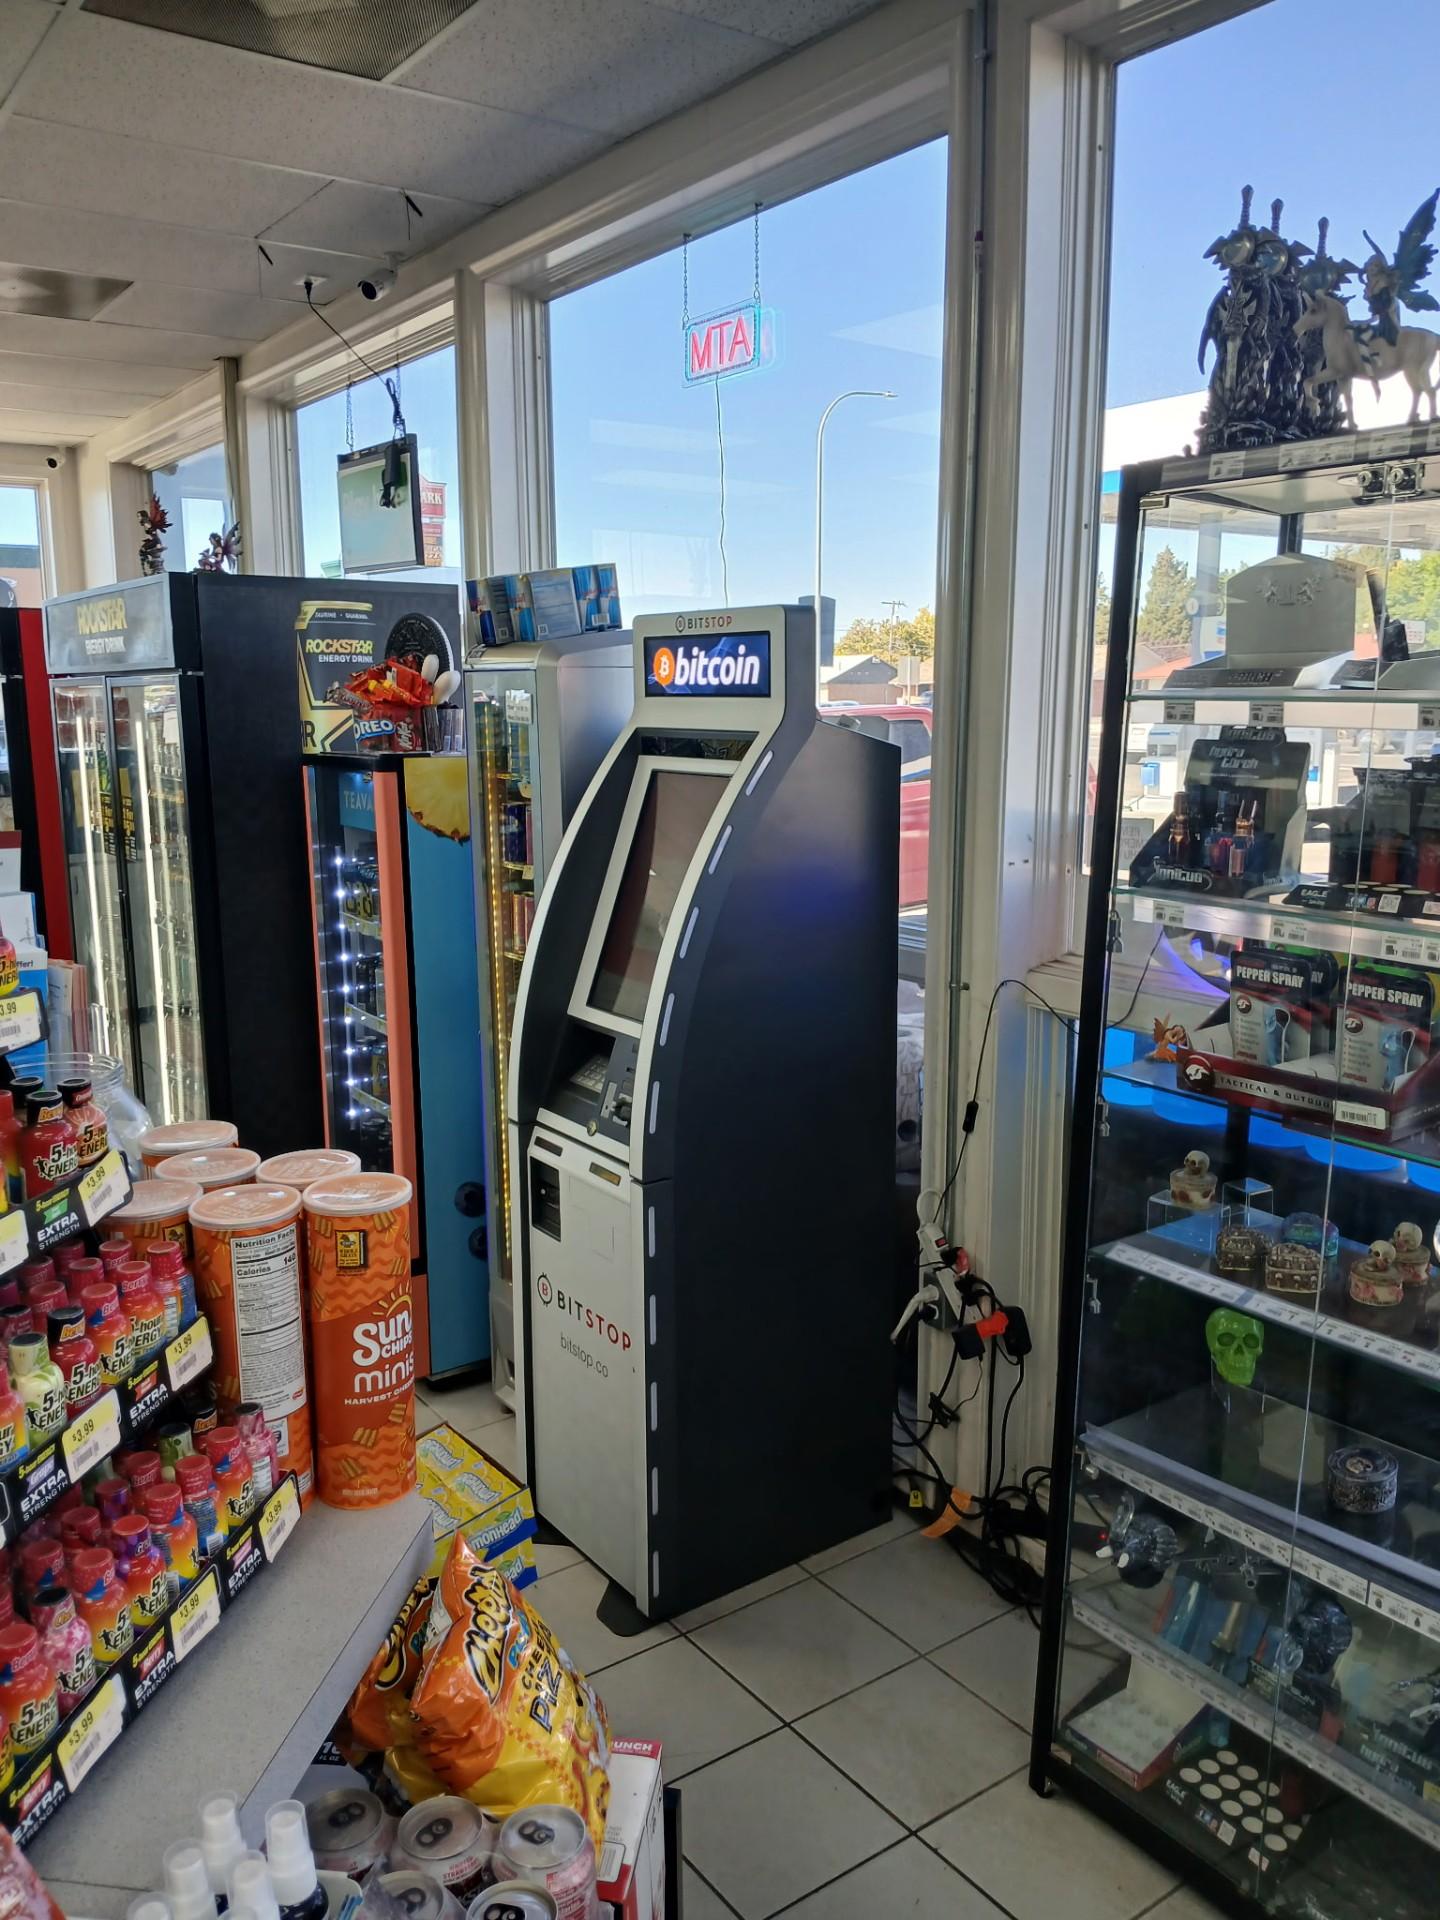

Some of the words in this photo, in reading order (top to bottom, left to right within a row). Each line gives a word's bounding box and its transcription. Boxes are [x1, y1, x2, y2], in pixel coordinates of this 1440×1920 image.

[687, 615, 733, 630] BITSTOP
[305, 638, 373, 654] ROCKSTAR
[318, 654, 351, 663] ENERGY
[351, 655, 373, 663] DRINK
[674, 644, 760, 686] bitcoin
[353, 719, 394, 739] OREO
[1301, 888, 1328, 898] EAGLE
[1236, 965, 1270, 981] PEPPER
[1272, 972, 1305, 989] SPRAY
[1347, 982, 1386, 1000] PEPPER
[1387, 989, 1425, 1009] SPRAY
[1219, 1076, 1268, 1094] TACTICAL
[86, 1166, 107, 1188] $3.99
[37, 1211, 79, 1241] EXTRA
[39, 1223, 80, 1250] STRENGTH
[235, 1237, 276, 1248] Nutrition
[237, 1266, 271, 1276] Calories
[557, 1289, 632, 1351] BITSTOP
[174, 1334, 193, 1355] $3.99
[353, 1310, 412, 1366] Sun
[560, 1332, 609, 1378] bitstop.co
[354, 1351, 414, 1392] minis
[130, 1383, 168, 1419] EXTRA
[131, 1394, 169, 1427] STRENGTH
[344, 1392, 392, 1405] HARVEST
[72, 1418, 95, 1442] $3.99
[21, 1469, 67, 1511] EXTRA
[23, 1481, 69, 1521] STRENGTH
[265, 1500, 282, 1523] $3.99
[228, 1548, 261, 1589] EXTRA
[229, 1556, 263, 1597] STRENGTH
[179, 1593, 200, 1619] $3.99
[134, 1650, 175, 1700] EXTRA
[137, 1660, 177, 1709] STRENGTH
[69, 1711, 94, 1747] $3.99
[611, 1740, 653, 1751] UNCH
[12, 1780, 64, 1843] EXTRA
